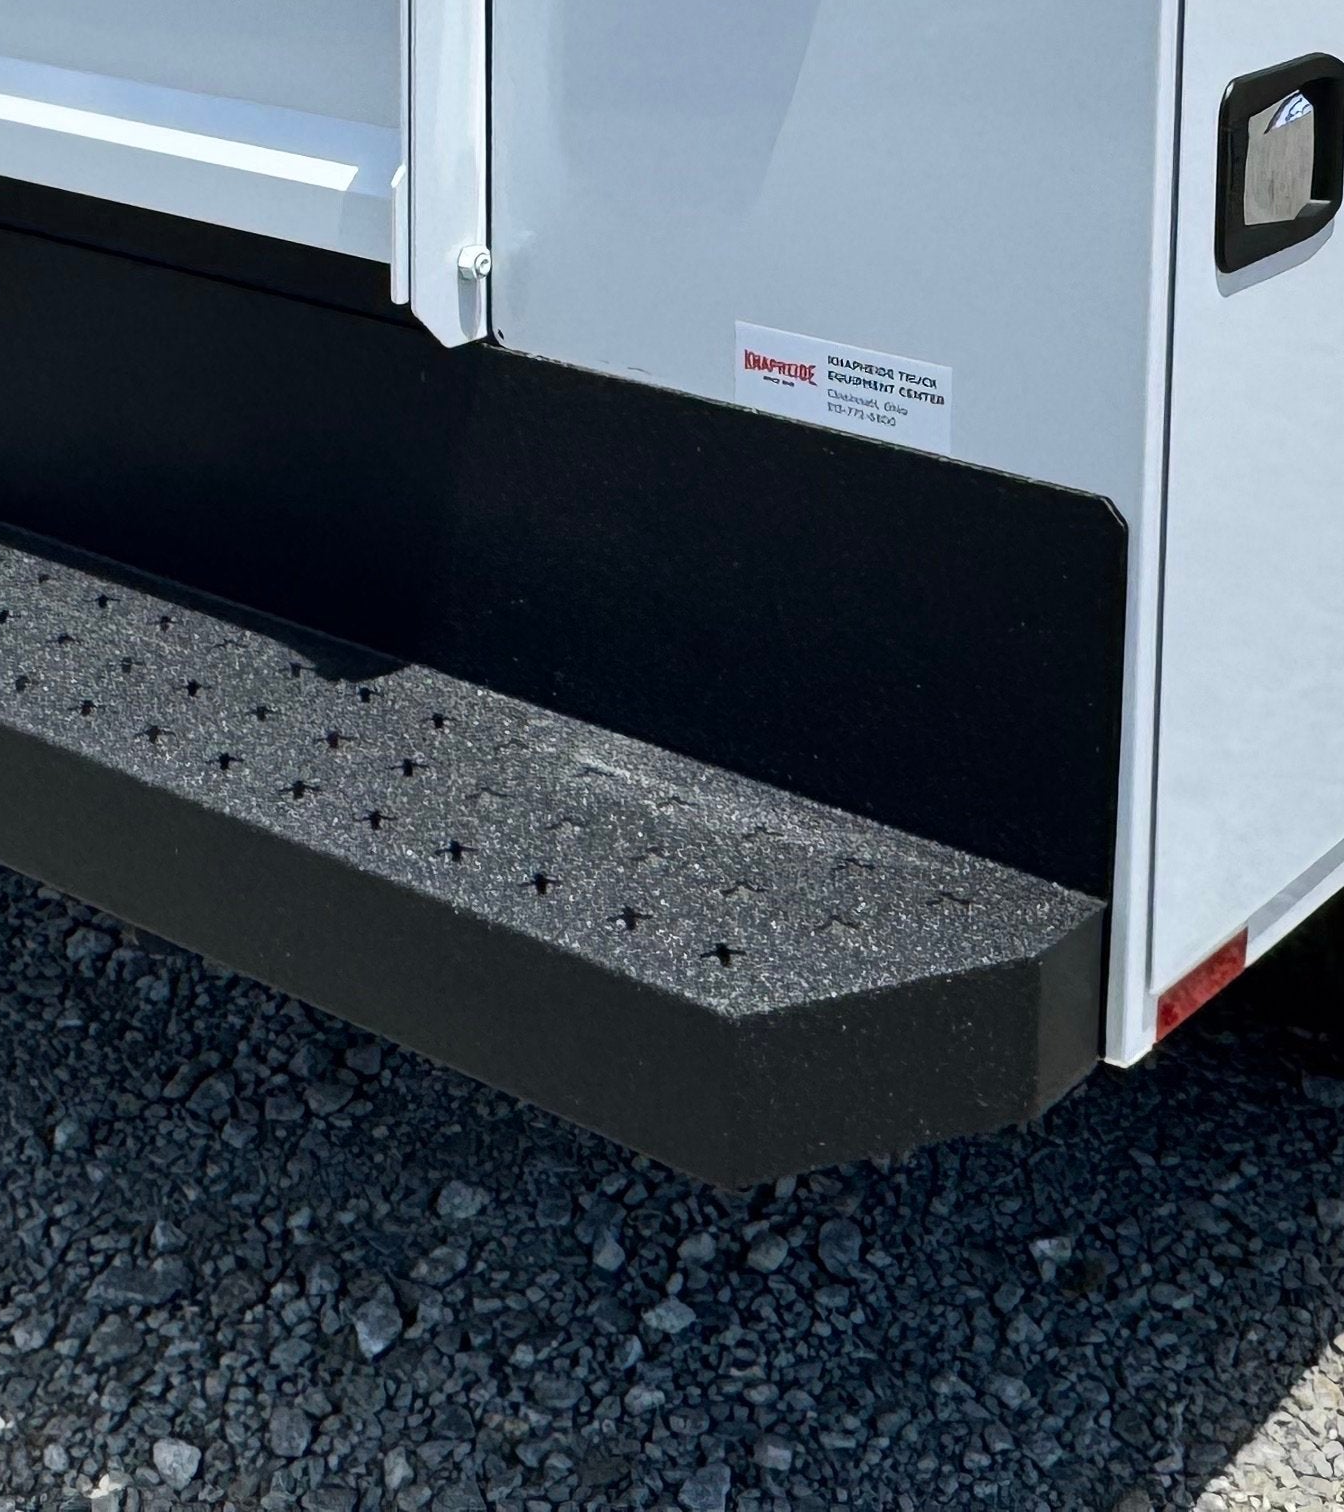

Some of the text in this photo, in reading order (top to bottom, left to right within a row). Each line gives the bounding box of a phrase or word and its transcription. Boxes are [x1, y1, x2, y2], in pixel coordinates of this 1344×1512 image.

[827, 370, 945, 405] EQUIPMENT CENTER
[898, 371, 937, 389] TRUCK
